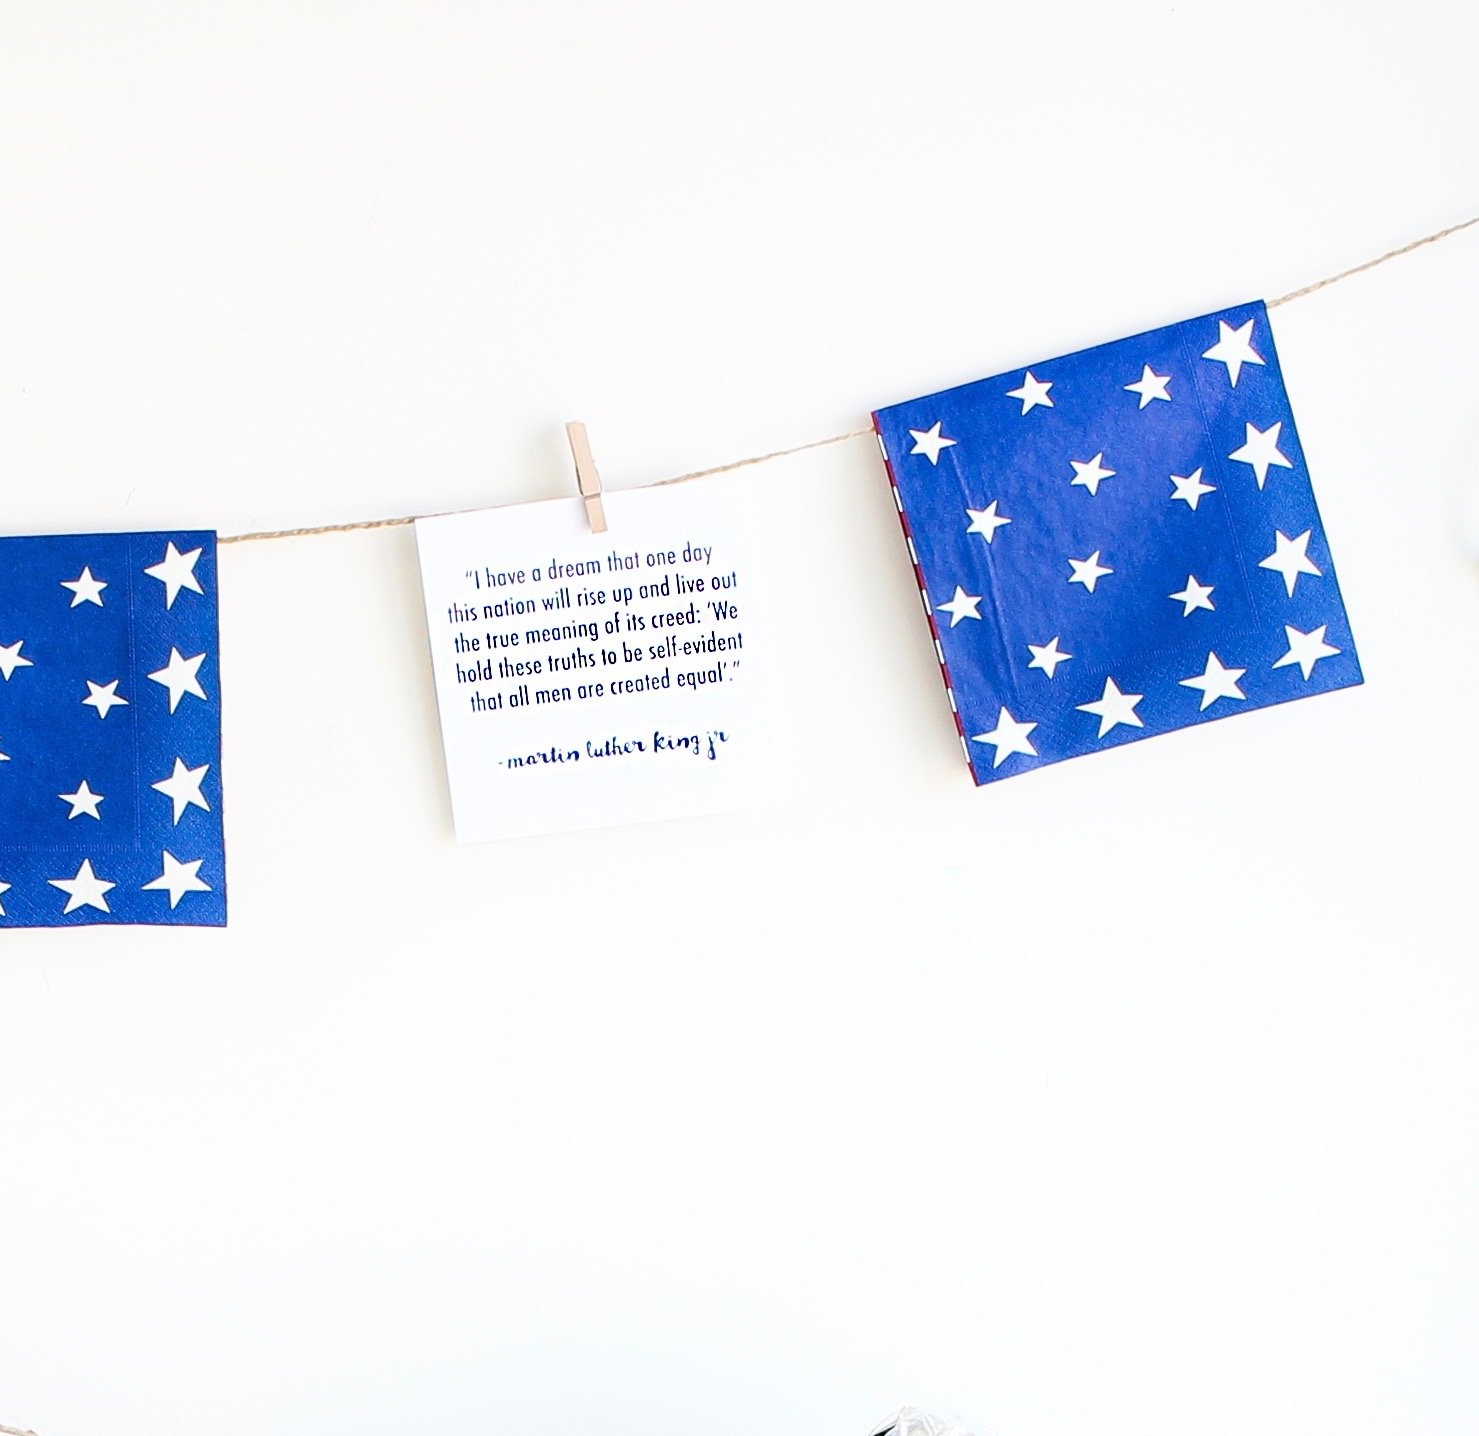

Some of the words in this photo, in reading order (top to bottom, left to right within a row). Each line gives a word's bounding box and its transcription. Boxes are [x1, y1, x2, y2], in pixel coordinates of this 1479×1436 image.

[485, 567, 526, 588] have
[531, 568, 542, 582] a
[547, 558, 601, 580] dream
[607, 550, 640, 572] that
[646, 551, 676, 568] one
[682, 540, 712, 566] day
[447, 602, 478, 624] this
[483, 599, 536, 620] nation
[541, 586, 571, 611] will
[577, 587, 606, 607] rise
[612, 587, 633, 607] up
[639, 574, 670, 599] and
[675, 573, 705, 595] live
[711, 571, 737, 591] out
[454, 632, 481, 654] the
[485, 632, 520, 650] true
[525, 619, 599, 645] meaning
[604, 611, 621, 635] of
[626, 614, 646, 632] its
[651, 601, 701, 629] creed:
[455, 658, 493, 684] hold
[498, 656, 542, 679] these
[547, 646, 596, 673] truths
[601, 648, 617, 666] to
[622, 641, 643, 663] be
[648, 630, 743, 660] self-evident
[470, 691, 503, 713] that
[509, 684, 530, 708] all
[535, 687, 572, 705] men
[577, 683, 604, 700] are
[610, 666, 671, 696] created
[586, 736, 646, 759] luther
[653, 730, 700, 756] king
